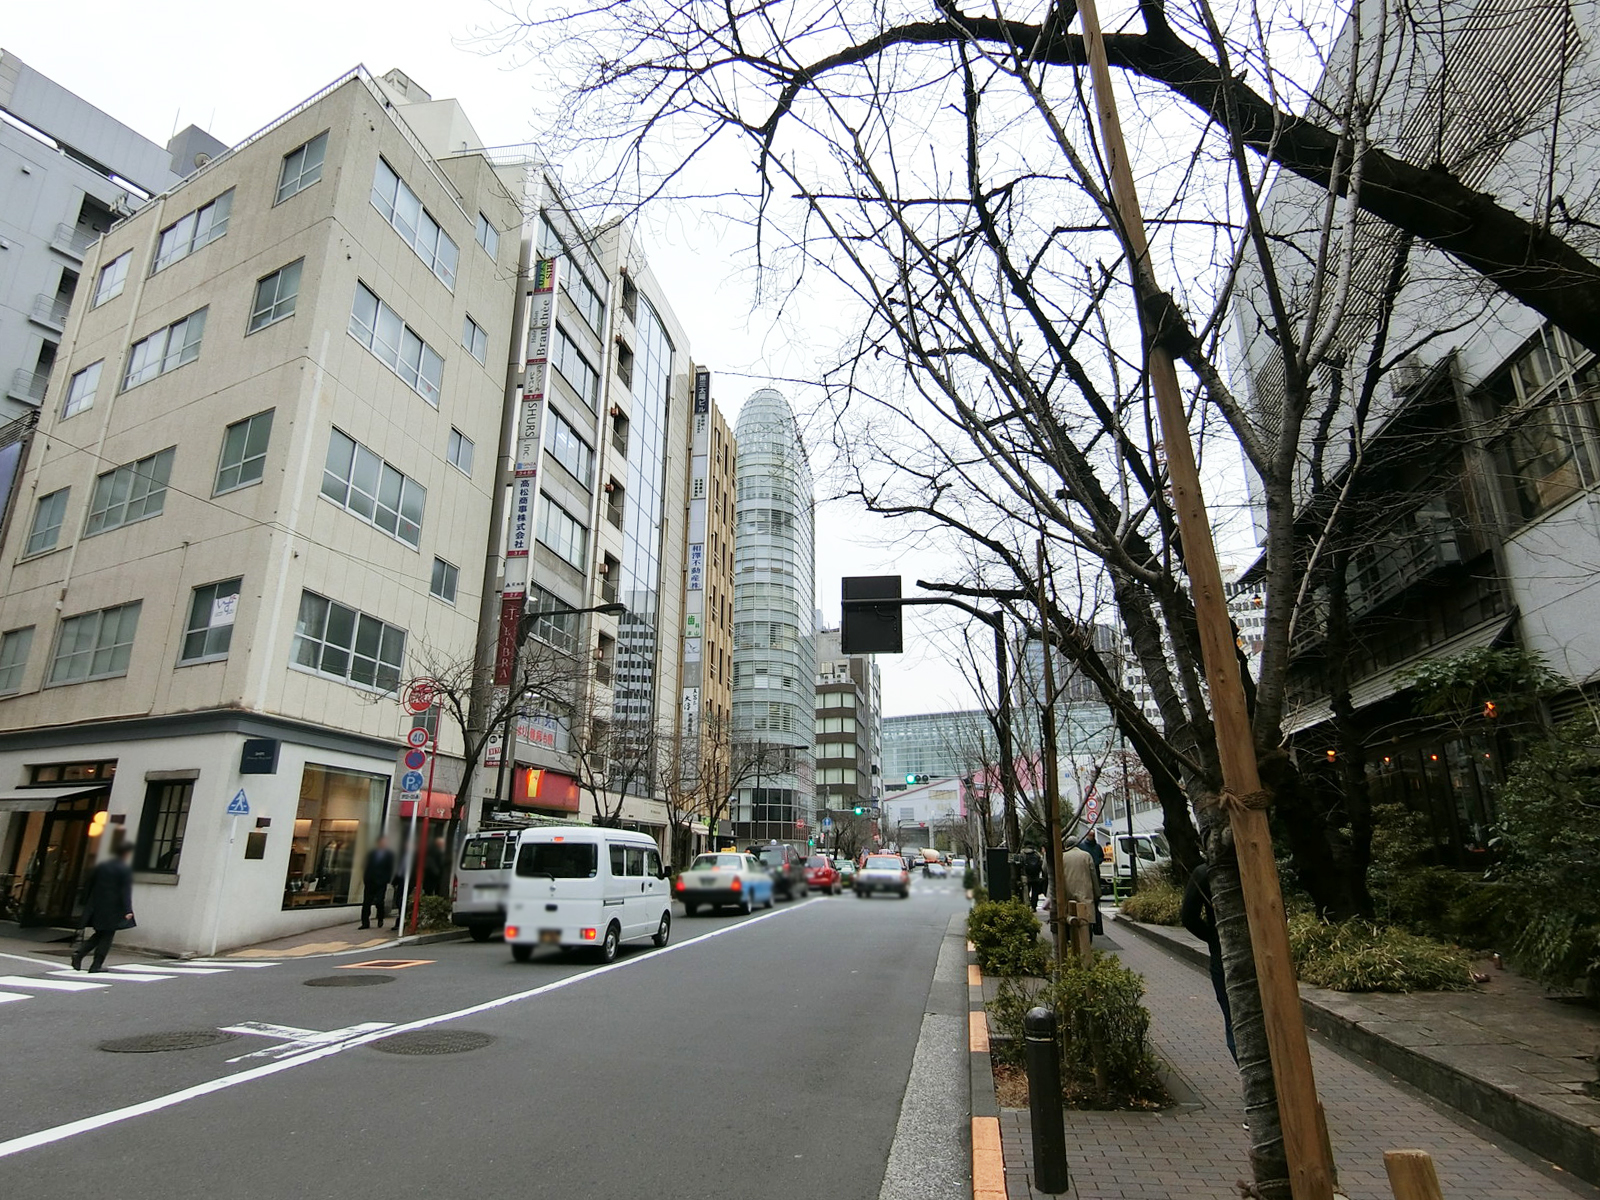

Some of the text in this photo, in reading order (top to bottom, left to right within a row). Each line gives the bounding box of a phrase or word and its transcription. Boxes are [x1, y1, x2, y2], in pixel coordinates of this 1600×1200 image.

[514, 480, 530, 548] 高松商事株式会社
[412, 733, 424, 743] 40
[406, 776, 416, 790] P
